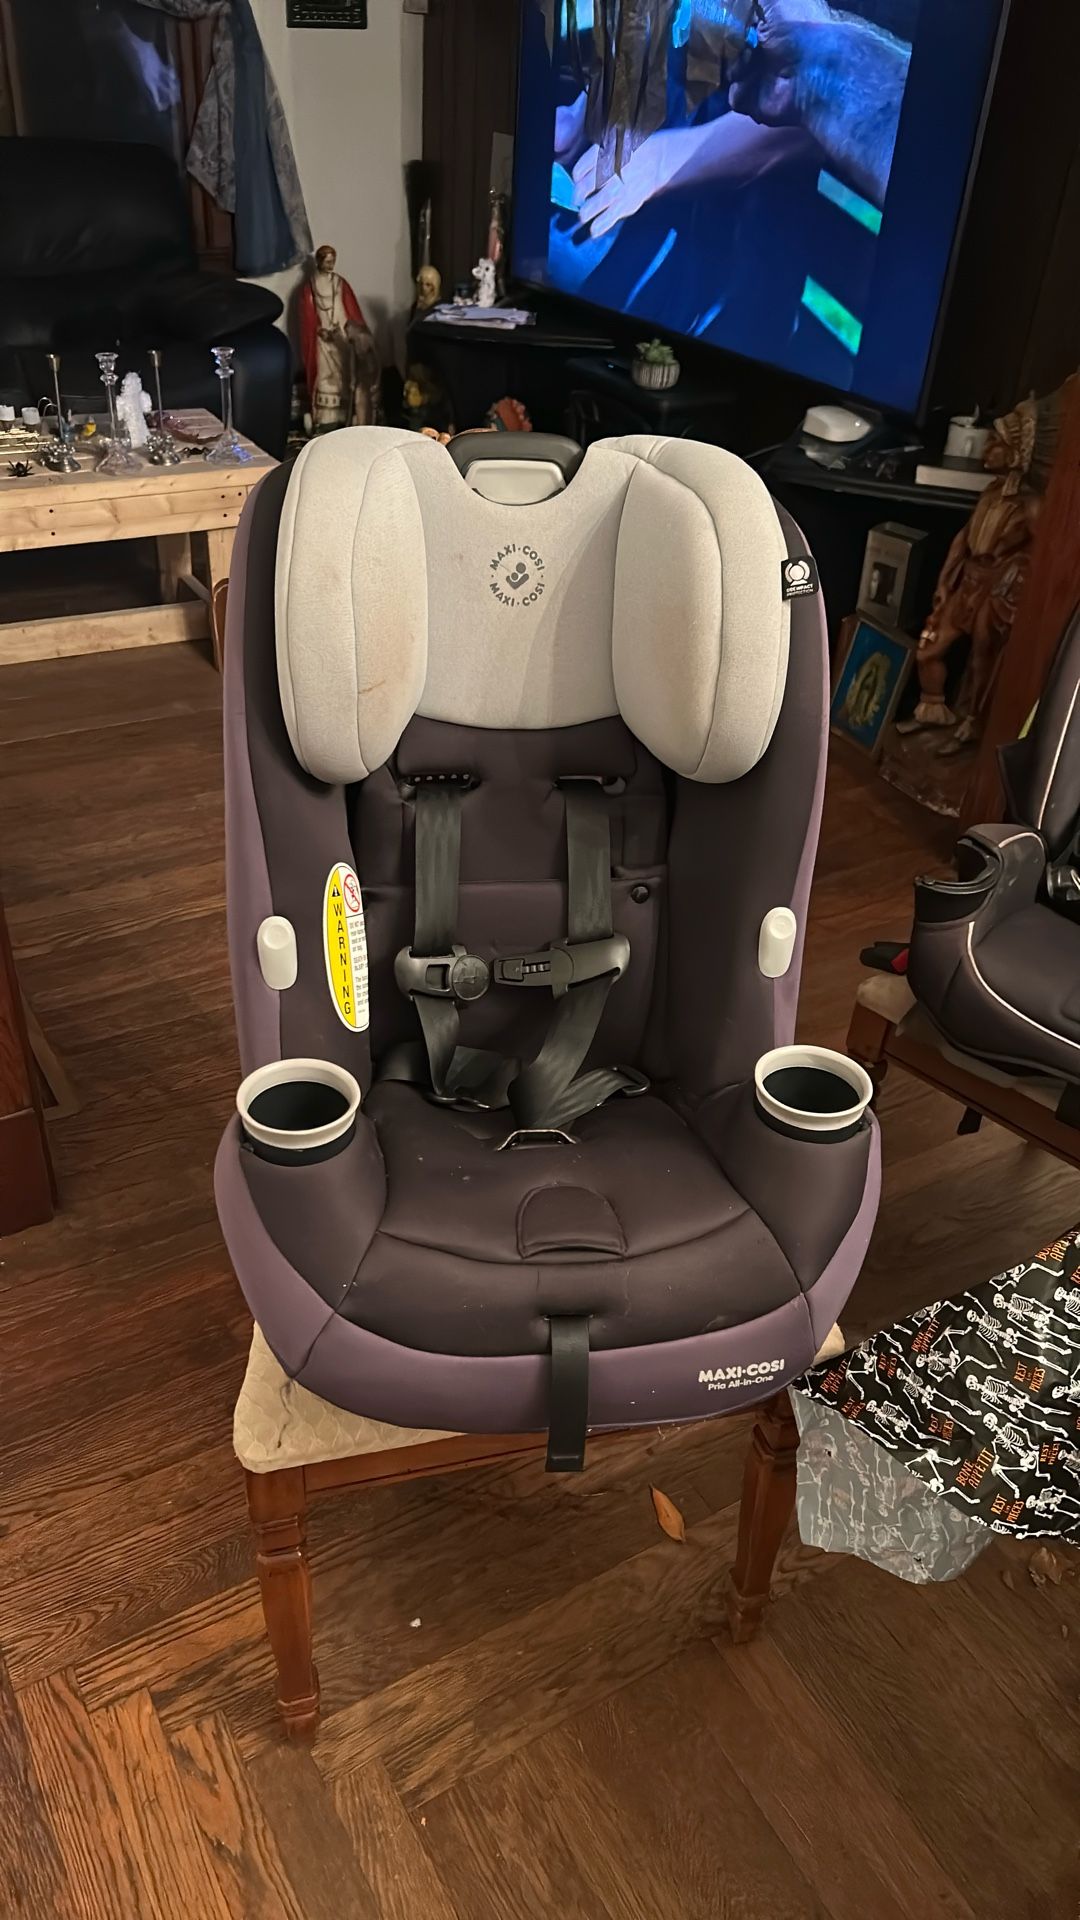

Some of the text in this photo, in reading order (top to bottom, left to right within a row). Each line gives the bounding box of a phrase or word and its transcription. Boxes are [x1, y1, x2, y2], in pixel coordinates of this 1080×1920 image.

[333, 903, 352, 1015] WARNING
[707, 1375, 774, 1391] Pria All-in-One
[1013, 1361, 1028, 1383] REST
[1029, 1366, 1046, 1393] PIECES
[956, 1459, 974, 1487] BONE
[968, 1447, 995, 1489] APPETIT
[990, 1493, 1008, 1515] REST
[1006, 1500, 1025, 1523] PIECES
